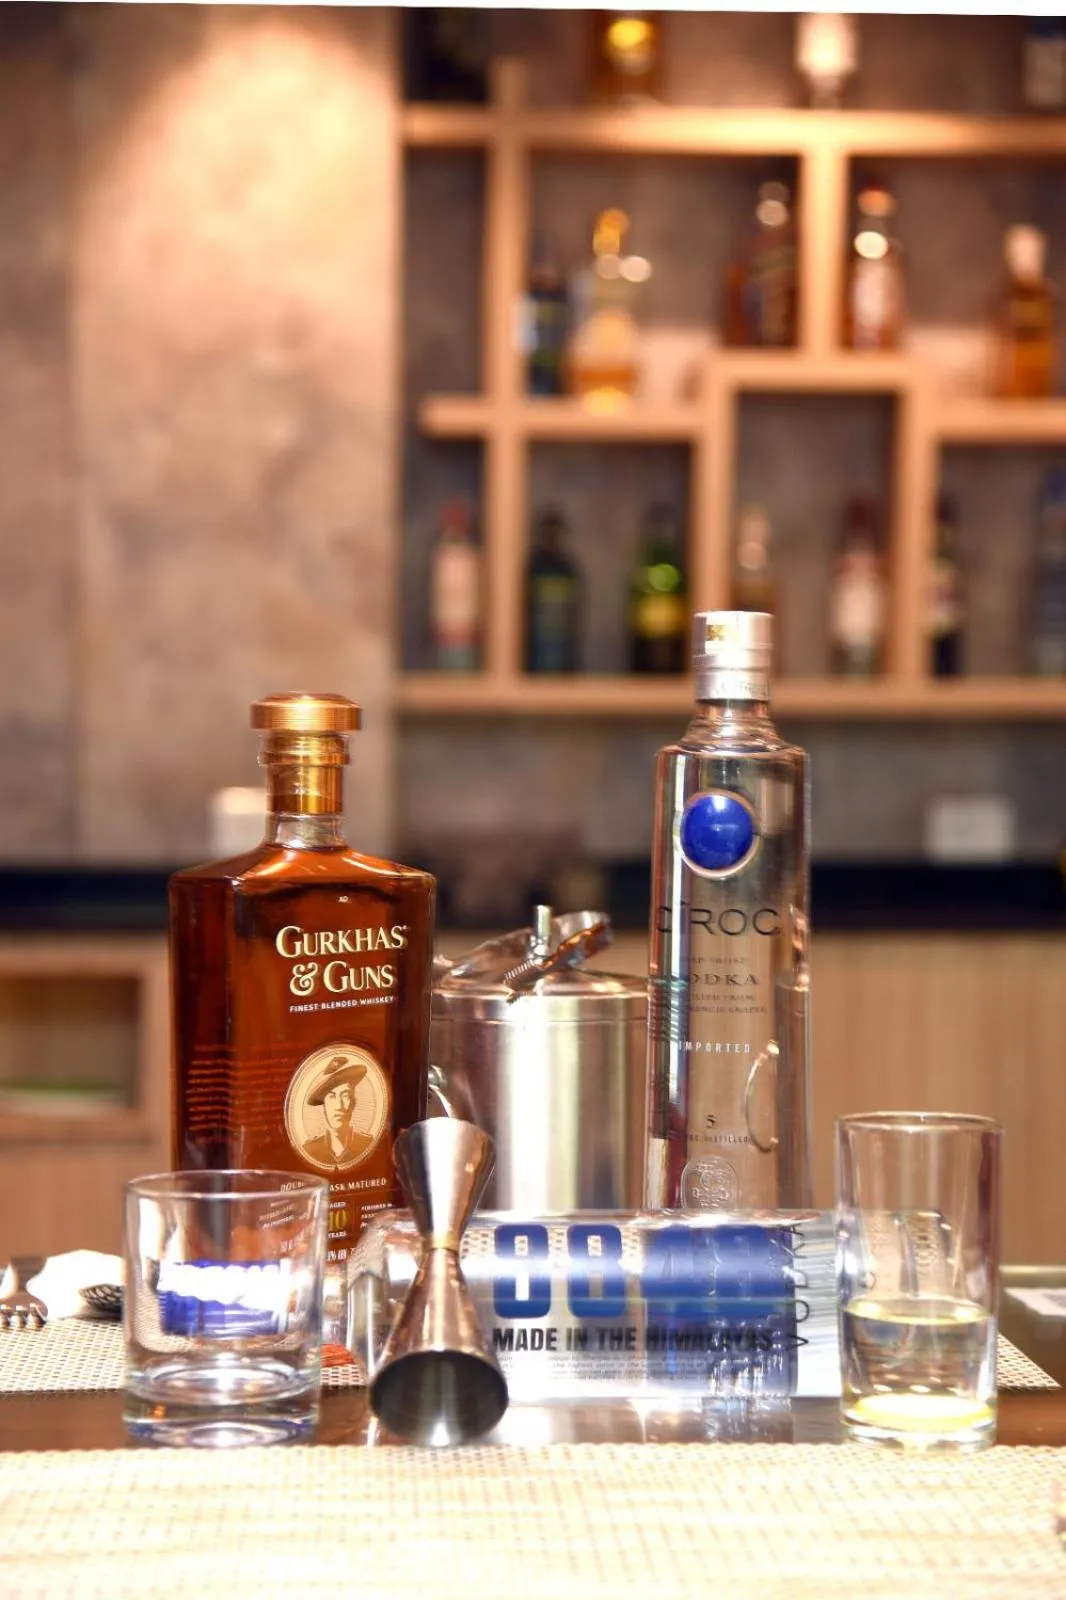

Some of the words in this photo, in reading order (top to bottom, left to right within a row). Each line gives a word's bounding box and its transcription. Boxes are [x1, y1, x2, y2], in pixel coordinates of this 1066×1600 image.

[275, 924, 405, 958] GURKHAS
[289, 962, 319, 996] &
[323, 960, 395, 993] GUNS
[289, 1003, 319, 1013] FINEST
[321, 1000, 358, 1010] BLENDED
[360, 996, 395, 1006] WHISKEY
[678, 1040, 751, 1053] IMPORTED
[705, 1114, 717, 1129] 5
[329, 1183, 345, 1192] ASK
[348, 1177, 387, 1190] MATURED
[328, 1209, 348, 1232] 10
[492, 1327, 557, 1351] MADE
[566, 1327, 588, 1351] IN
[598, 1327, 637, 1351] THE
